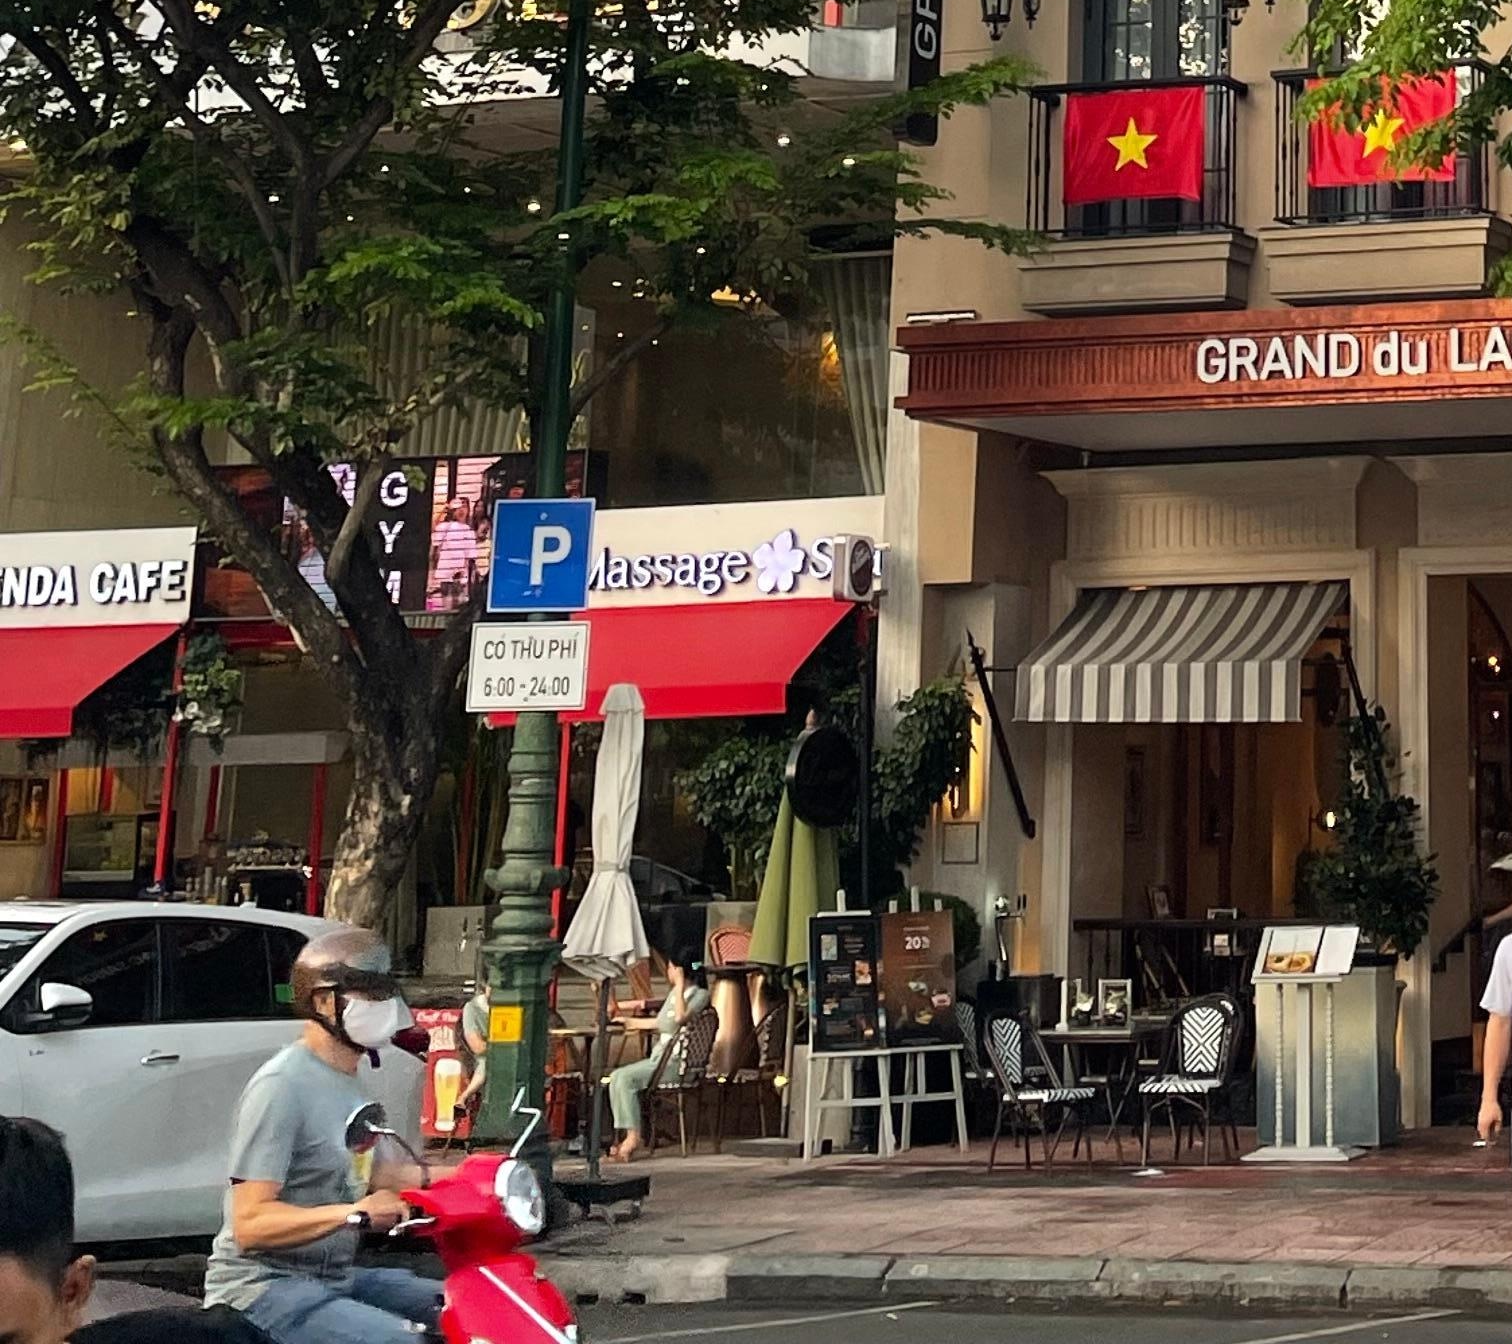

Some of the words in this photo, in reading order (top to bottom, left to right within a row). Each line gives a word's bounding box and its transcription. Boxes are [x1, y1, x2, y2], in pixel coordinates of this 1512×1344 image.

[1197, 332, 1360, 384] GRAND
[1372, 331, 1428, 377] du
[529, 525, 572, 586] P
[0, 565, 77, 607] NDA
[89, 560, 187, 604] CAFE
[483, 633, 506, 659] CÓ
[548, 632, 579, 660] PHÍ
